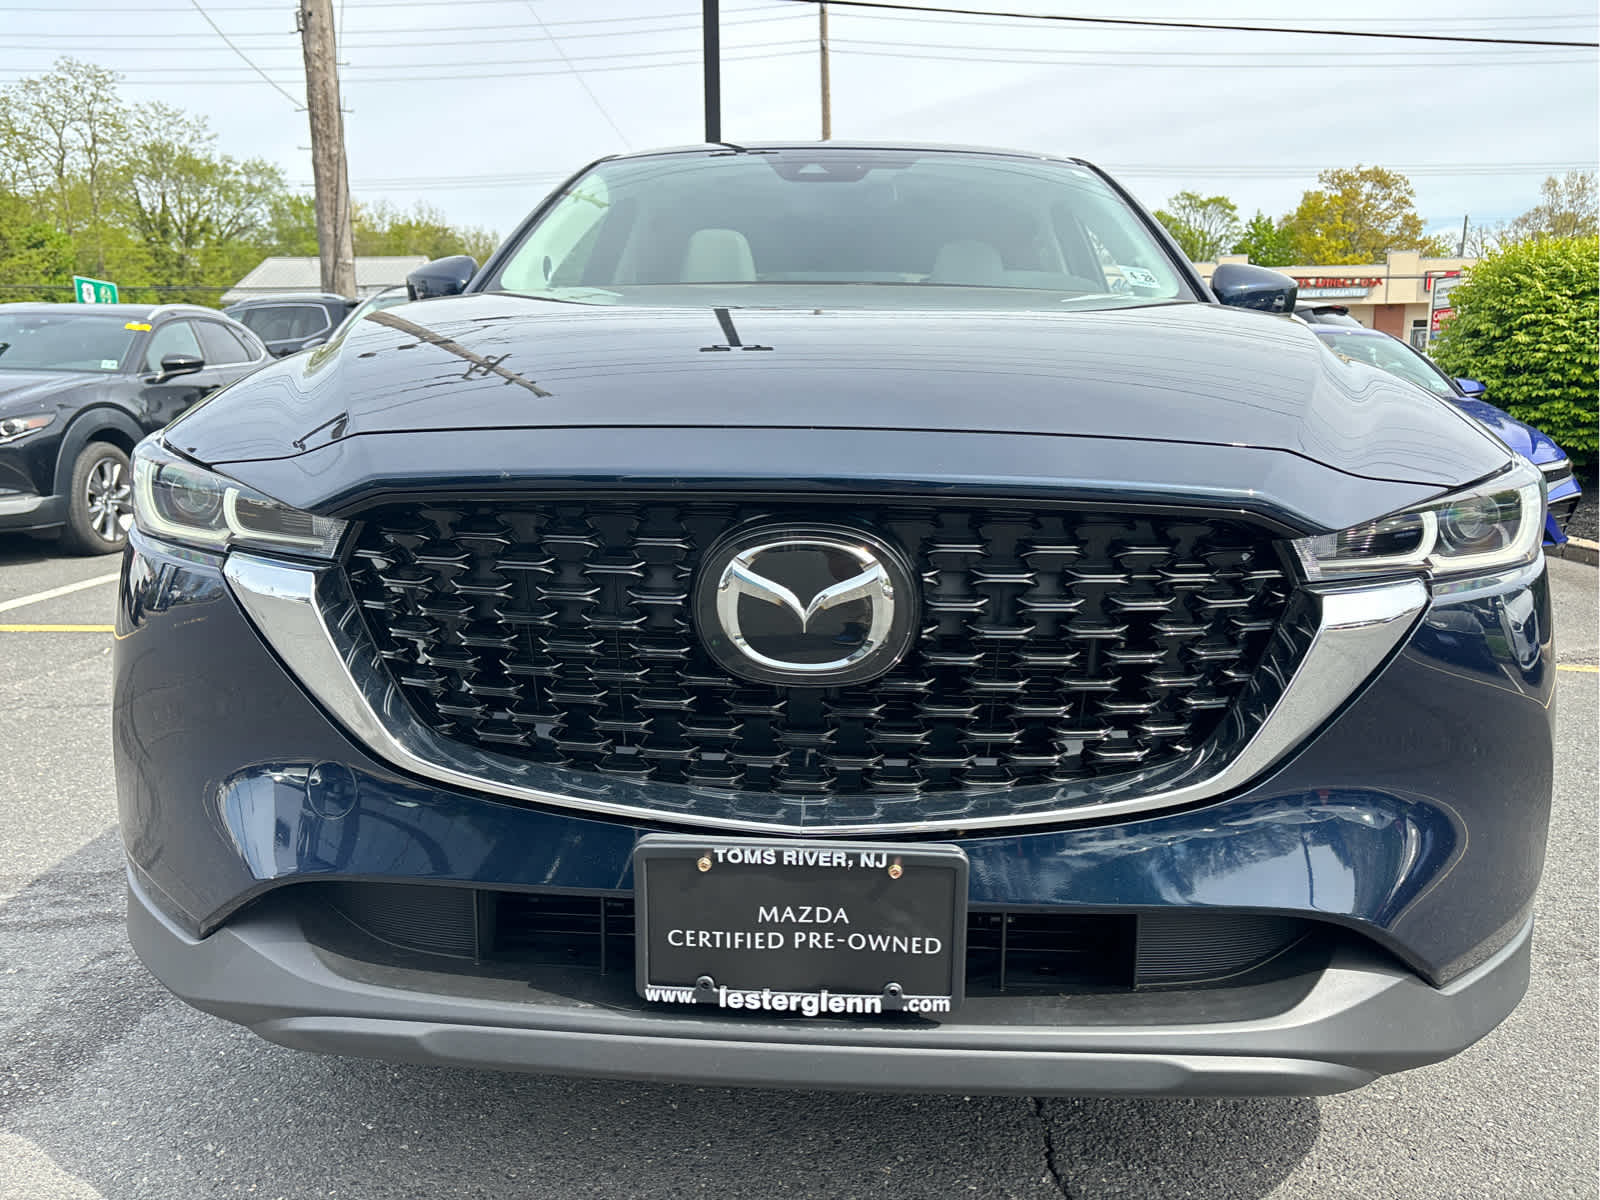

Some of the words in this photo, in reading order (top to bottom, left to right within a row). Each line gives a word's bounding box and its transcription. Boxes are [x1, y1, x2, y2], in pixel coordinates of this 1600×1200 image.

[714, 848, 777, 865] TOMS
[783, 849, 853, 868] RIVER,
[860, 852, 888, 869] NJ
[758, 905, 850, 924] MAZDA
[667, 929, 785, 950] CERTIFIED
[794, 932, 942, 955] PRE-OWNED
[645, 988, 697, 1004] www.
[719, 985, 882, 1017] lesterglenn
[902, 997, 951, 1013] .com
